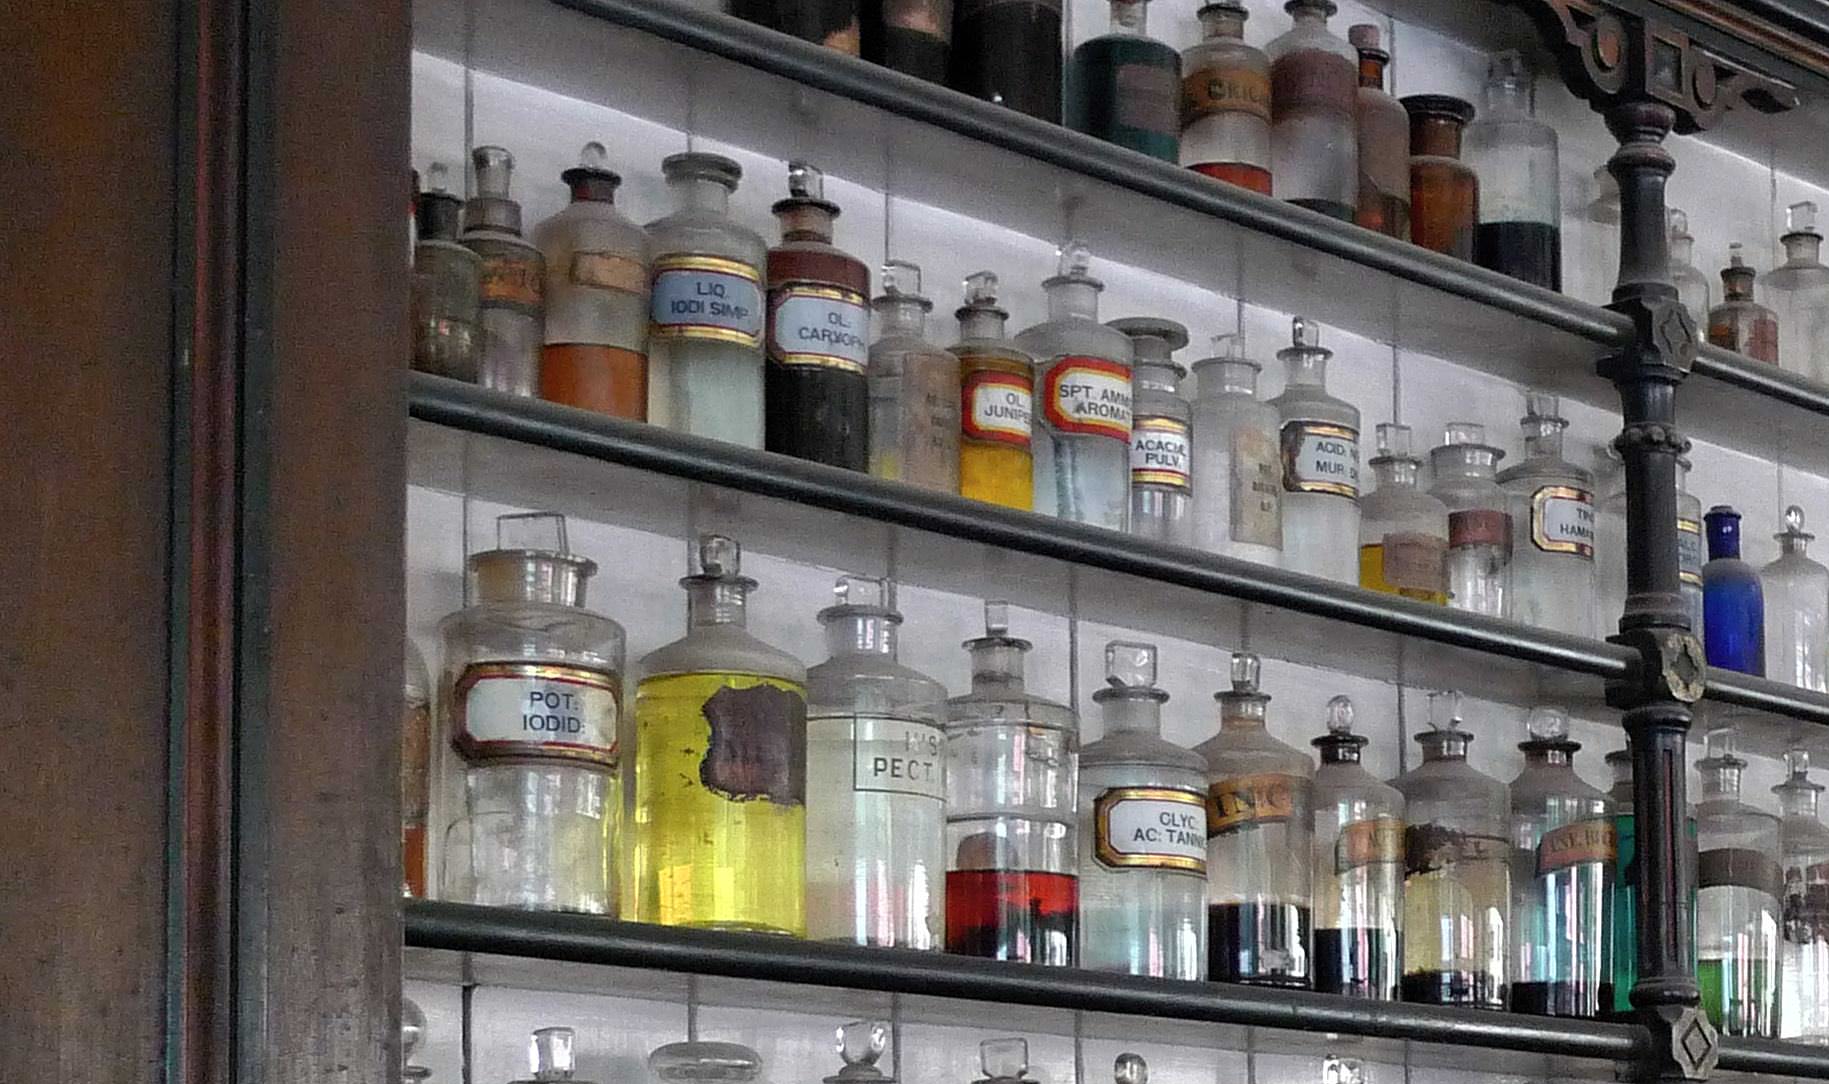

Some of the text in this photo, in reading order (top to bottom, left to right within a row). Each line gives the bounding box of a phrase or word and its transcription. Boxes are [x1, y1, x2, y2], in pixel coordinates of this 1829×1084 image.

[671, 300, 705, 314] IODI
[530, 691, 579, 711] POT:
[522, 714, 586, 734] IODID:
